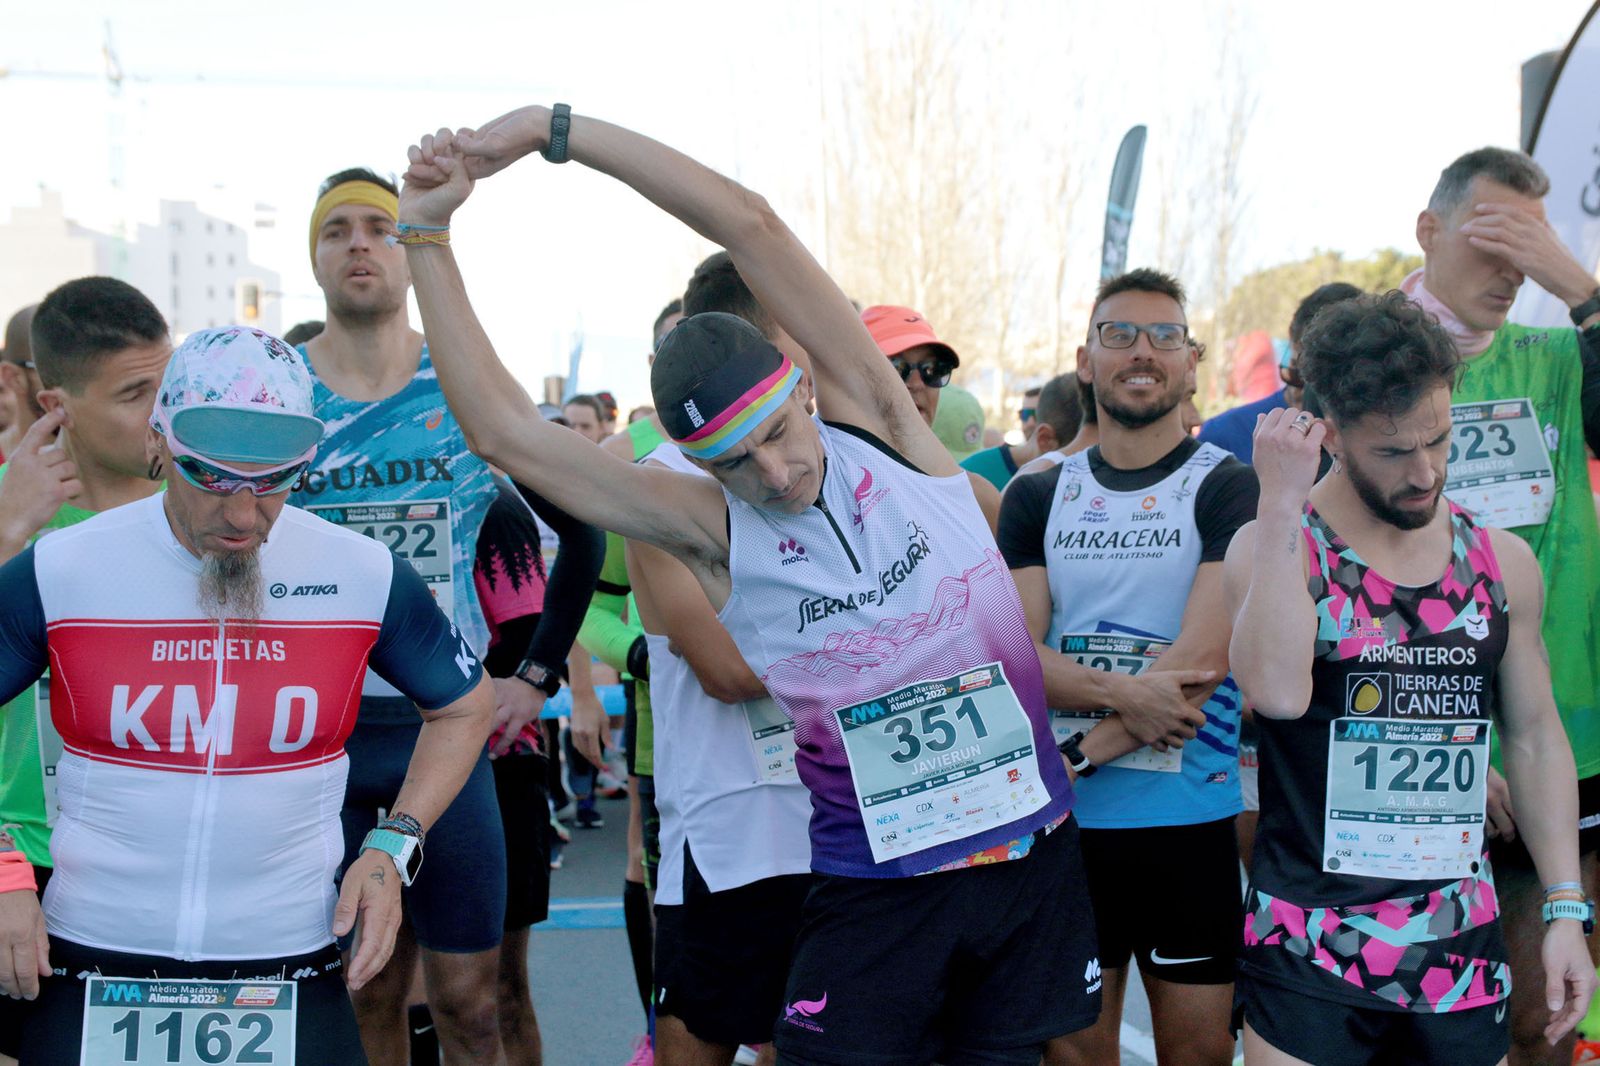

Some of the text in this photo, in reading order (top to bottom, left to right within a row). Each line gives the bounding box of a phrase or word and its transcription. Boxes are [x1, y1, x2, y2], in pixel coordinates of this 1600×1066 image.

[684, 399, 705, 428] 226ERS
[303, 457, 454, 495] GUADIX
[1447, 460, 1516, 476] UBENATOR
[1053, 528, 1182, 549] MARACENA
[1064, 552, 1089, 560] CLUB
[291, 585, 339, 596] ATIKA
[151, 638, 286, 662] BICICLETAS
[1359, 644, 1477, 666] ARMENTEROS
[1395, 673, 1483, 692] TIERRAS DE
[887, 683, 945, 705] Medio Maratón
[890, 688, 948, 712] Almería 2022
[1395, 693, 1481, 716] CANENA
[109, 684, 238, 756] KM
[884, 696, 989, 763] 351
[1385, 723, 1444, 733] Medio Maratón
[1385, 731, 1419, 741] Almería
[1419, 734, 1443, 742] 2022
[911, 743, 982, 776] JAVIERUN
[1354, 745, 1476, 793] 1220
[916, 801, 934, 814] CDX
[876, 813, 900, 826] NEXA
[1337, 832, 1360, 842] NEXA
[1377, 833, 1396, 843] CDX
[148, 992, 218, 1004] Almería 2022
[149, 984, 219, 995] Medio Maratón
[112, 1009, 274, 1064] 1162
